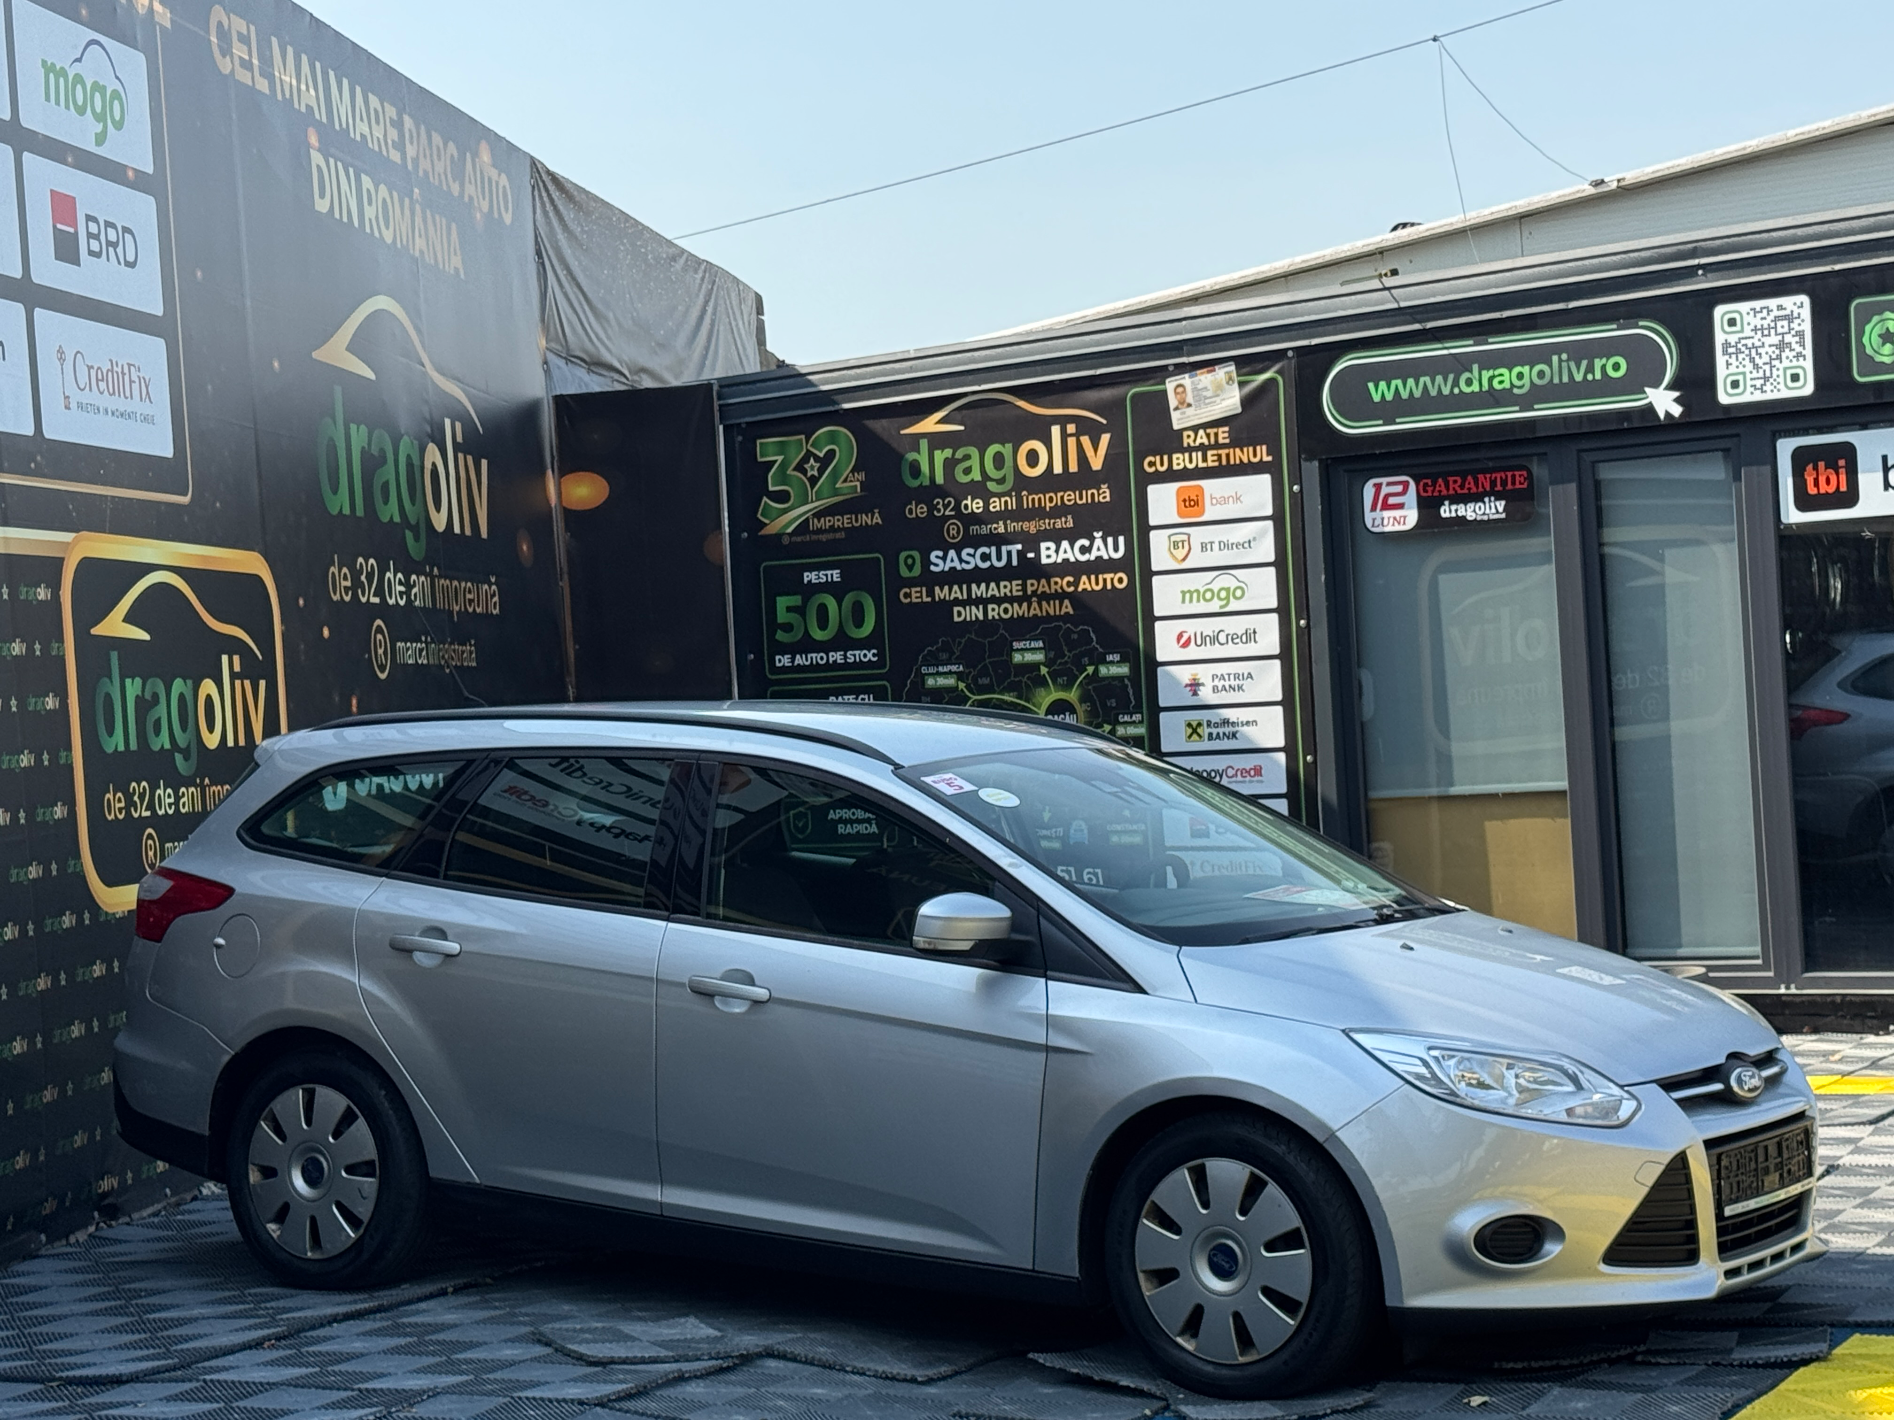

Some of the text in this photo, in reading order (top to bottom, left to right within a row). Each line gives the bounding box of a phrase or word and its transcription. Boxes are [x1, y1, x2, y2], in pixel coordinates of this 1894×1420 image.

[41, 58, 125, 147] mogo
[209, 5, 512, 225] CEL MAI MARE PARC AUTO
[310, 148, 465, 279] DIN ROMÂNIA
[84, 213, 138, 269] BRD
[73, 351, 153, 404] CreditFix
[1367, 353, 1628, 403] www.dragoliv.ro
[76, 401, 101, 415] PRIETEN
[102, 406, 109, 416] IN
[110, 408, 138, 422] MOMENTE
[1183, 426, 1230, 447] RATE
[900, 423, 1111, 493] dragoliv
[1143, 444, 1273, 473] CU BULETINUL
[318, 385, 488, 561] dragoliv
[757, 426, 857, 524] 32
[847, 471, 866, 483] ANI
[1804, 458, 1848, 495] tbi
[905, 483, 1111, 518] de 32 de ani împreună
[1182, 491, 1243, 508] tbi bank
[1369, 470, 1529, 513] 12 GARANTIE
[809, 509, 882, 531] ÎMPREUNĂ
[1439, 496, 1506, 521] dragoliv
[969, 520, 1005, 537] marcă
[1007, 515, 1074, 534] înregistrată
[1371, 515, 1407, 528] LUNI
[929, 544, 1022, 573] SASCUT
[1040, 531, 1125, 565] BACĂU
[1172, 540, 1187, 550] BT
[1200, 541, 1215, 553] BT
[328, 554, 500, 622] de 32 de ani împreună
[803, 569, 841, 584] PESTE
[899, 572, 1128, 603] CEL MAI MARE PARC AUTO
[19, 583, 51, 604] dragoliv
[1180, 586, 1246, 610] mogo
[775, 590, 876, 643] 500
[953, 598, 1074, 622] DIN ROMÂNIA
[1012, 640, 1044, 650] SUCEAVA
[1194, 627, 1258, 647] UniCredit
[396, 635, 427, 665] marcă
[775, 649, 878, 667] DE AUTO PE STOC
[921, 664, 964, 674] CLUJ-NAPOCA
[1211, 672, 1254, 683] PATRIA
[1212, 683, 1246, 694] BANK
[27, 692, 59, 714] dragoliv
[95, 651, 266, 776] dragoliv
[1206, 717, 1258, 729] Raiffeisen
[1207, 730, 1239, 742] BANK
[1, 749, 35, 772] dragoliv
[1190, 764, 1264, 784] ppyCredit
[104, 783, 125, 820] de
[129, 781, 151, 818] 32
[155, 780, 175, 816] de
[179, 778, 202, 814] ani
[36, 801, 68, 824] dragoliv
[837, 820, 879, 835] RAPIDĂ
[9, 861, 43, 884] dragoliv
[44, 910, 76, 934] dragoliv
[1740, 1071, 1761, 1091] Ford
